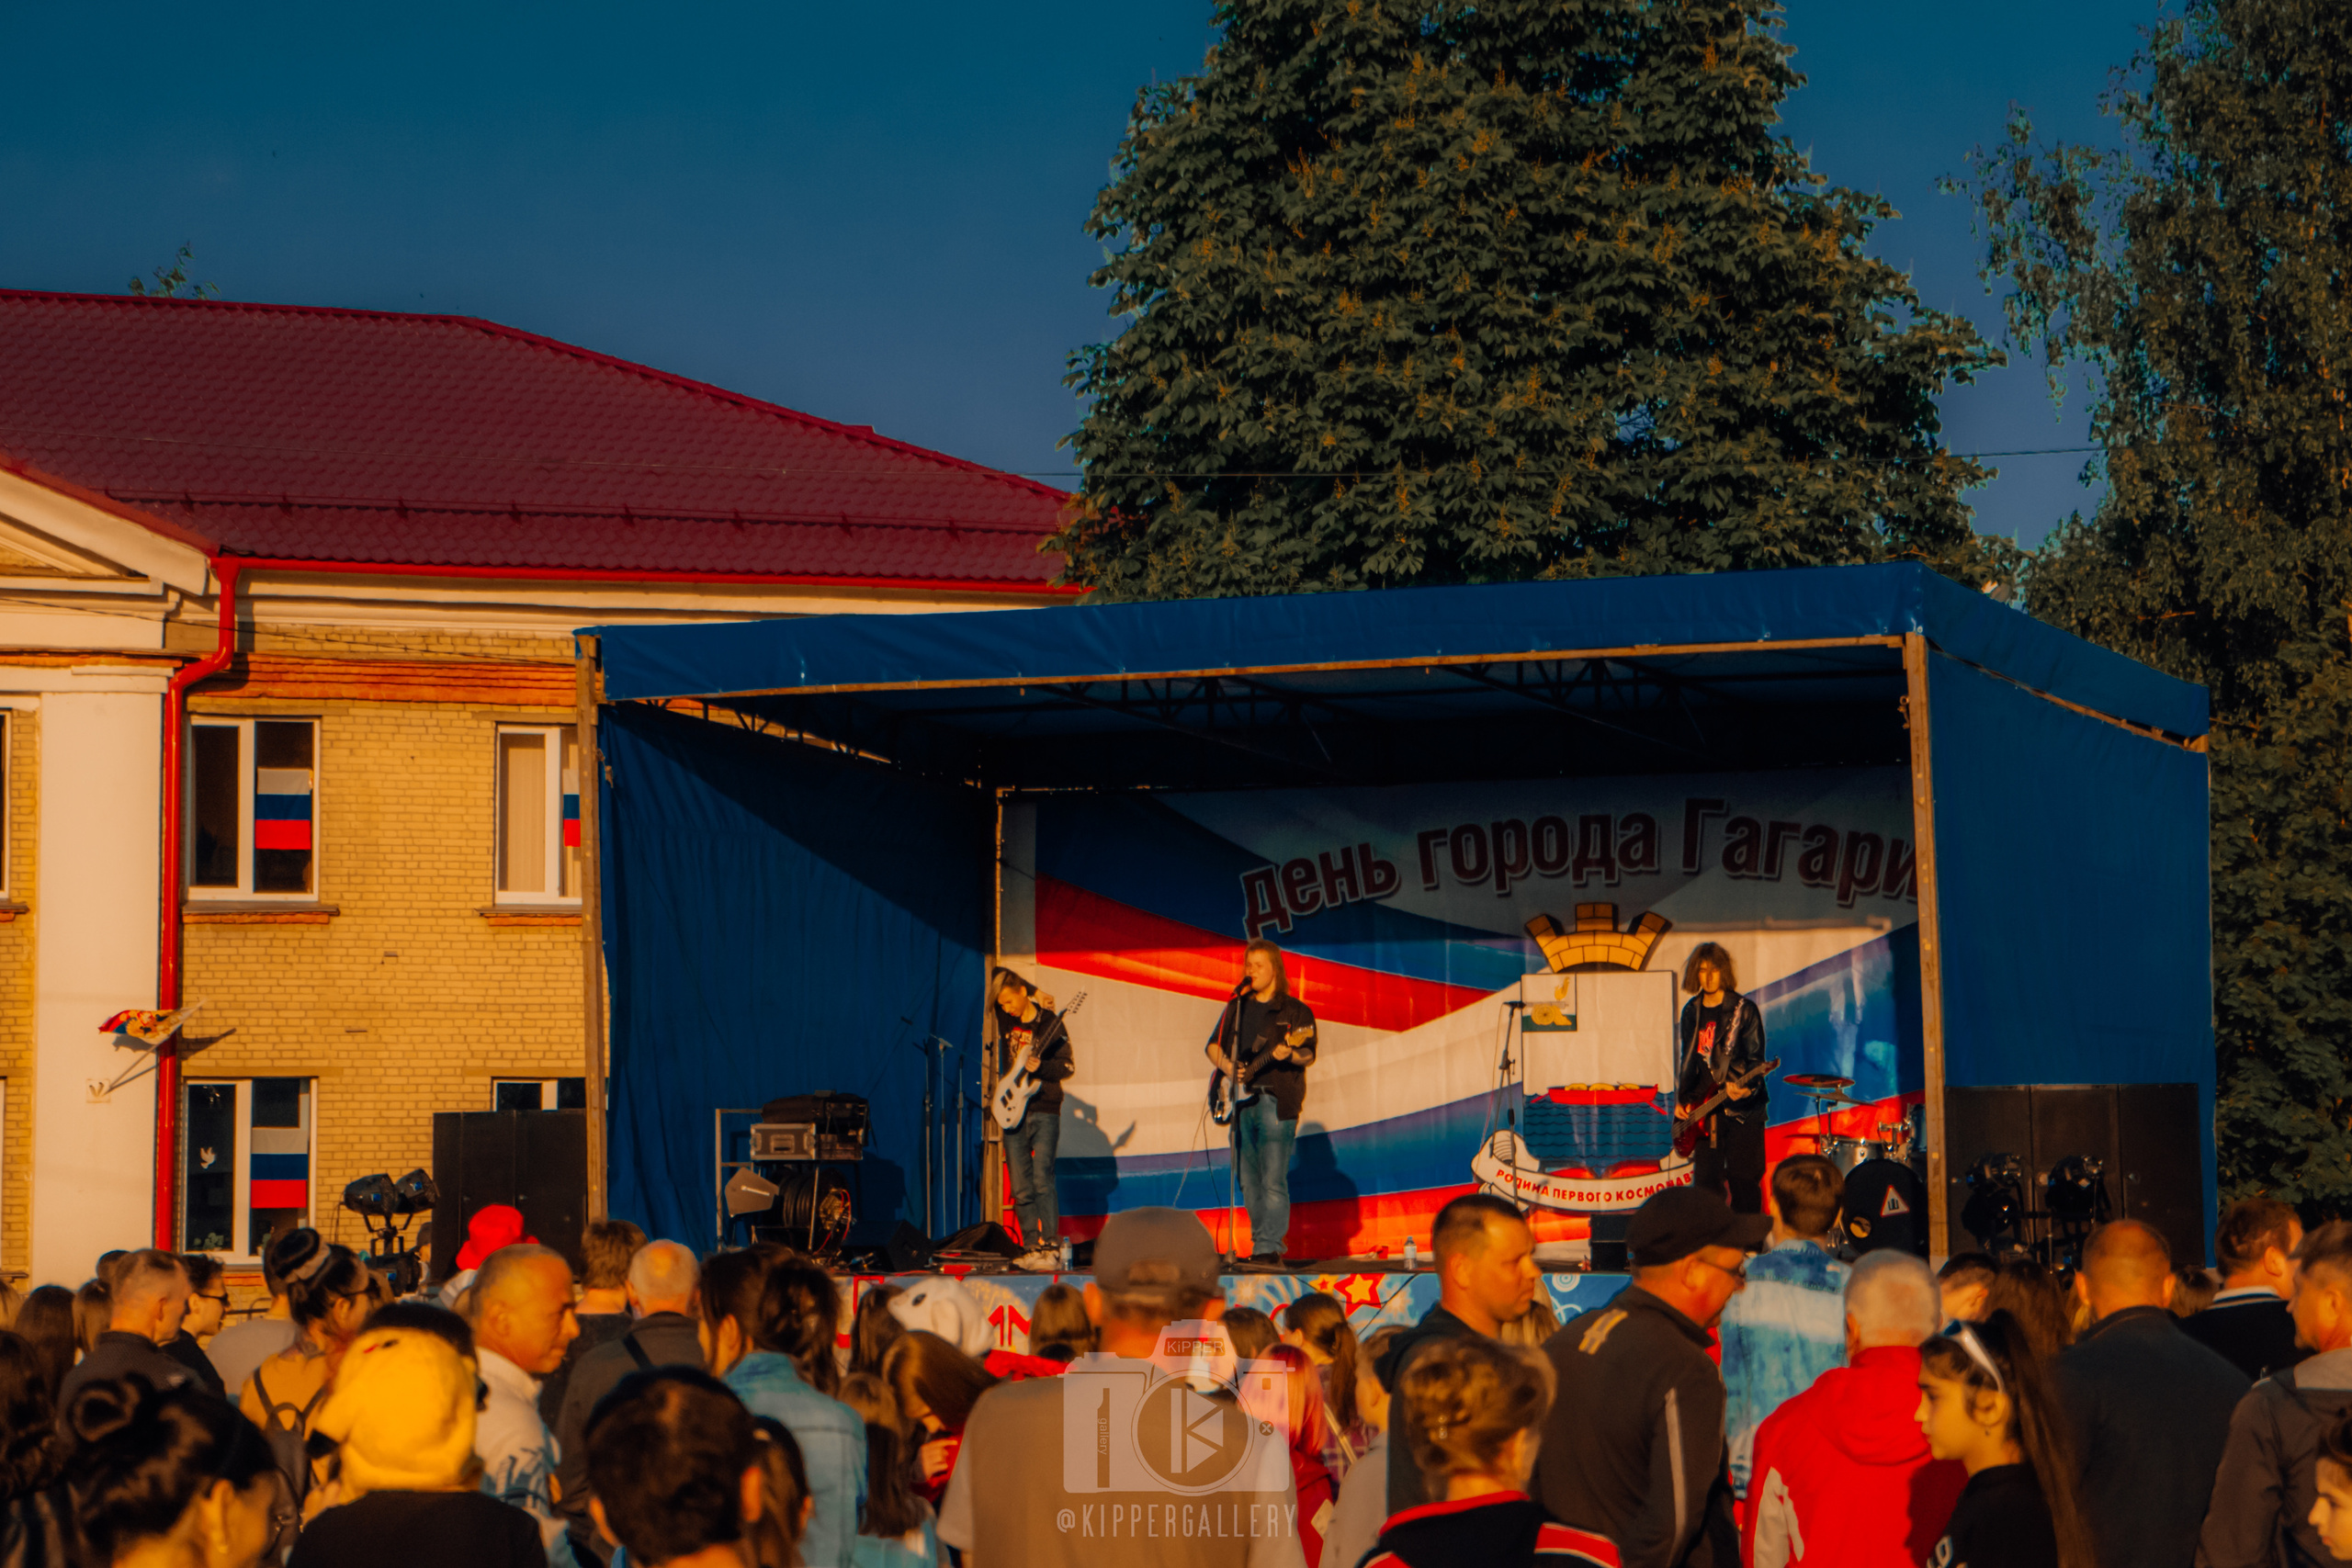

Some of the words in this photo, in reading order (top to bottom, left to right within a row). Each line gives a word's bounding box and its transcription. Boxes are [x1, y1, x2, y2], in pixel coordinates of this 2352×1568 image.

[1417, 812, 1659, 897] города
[1496, 1168, 1549, 1197] РОДИНА
[1553, 1188, 1611, 1202] ПЕРВОГО
[1616, 1169, 1695, 1201] КОСМОНАВ
